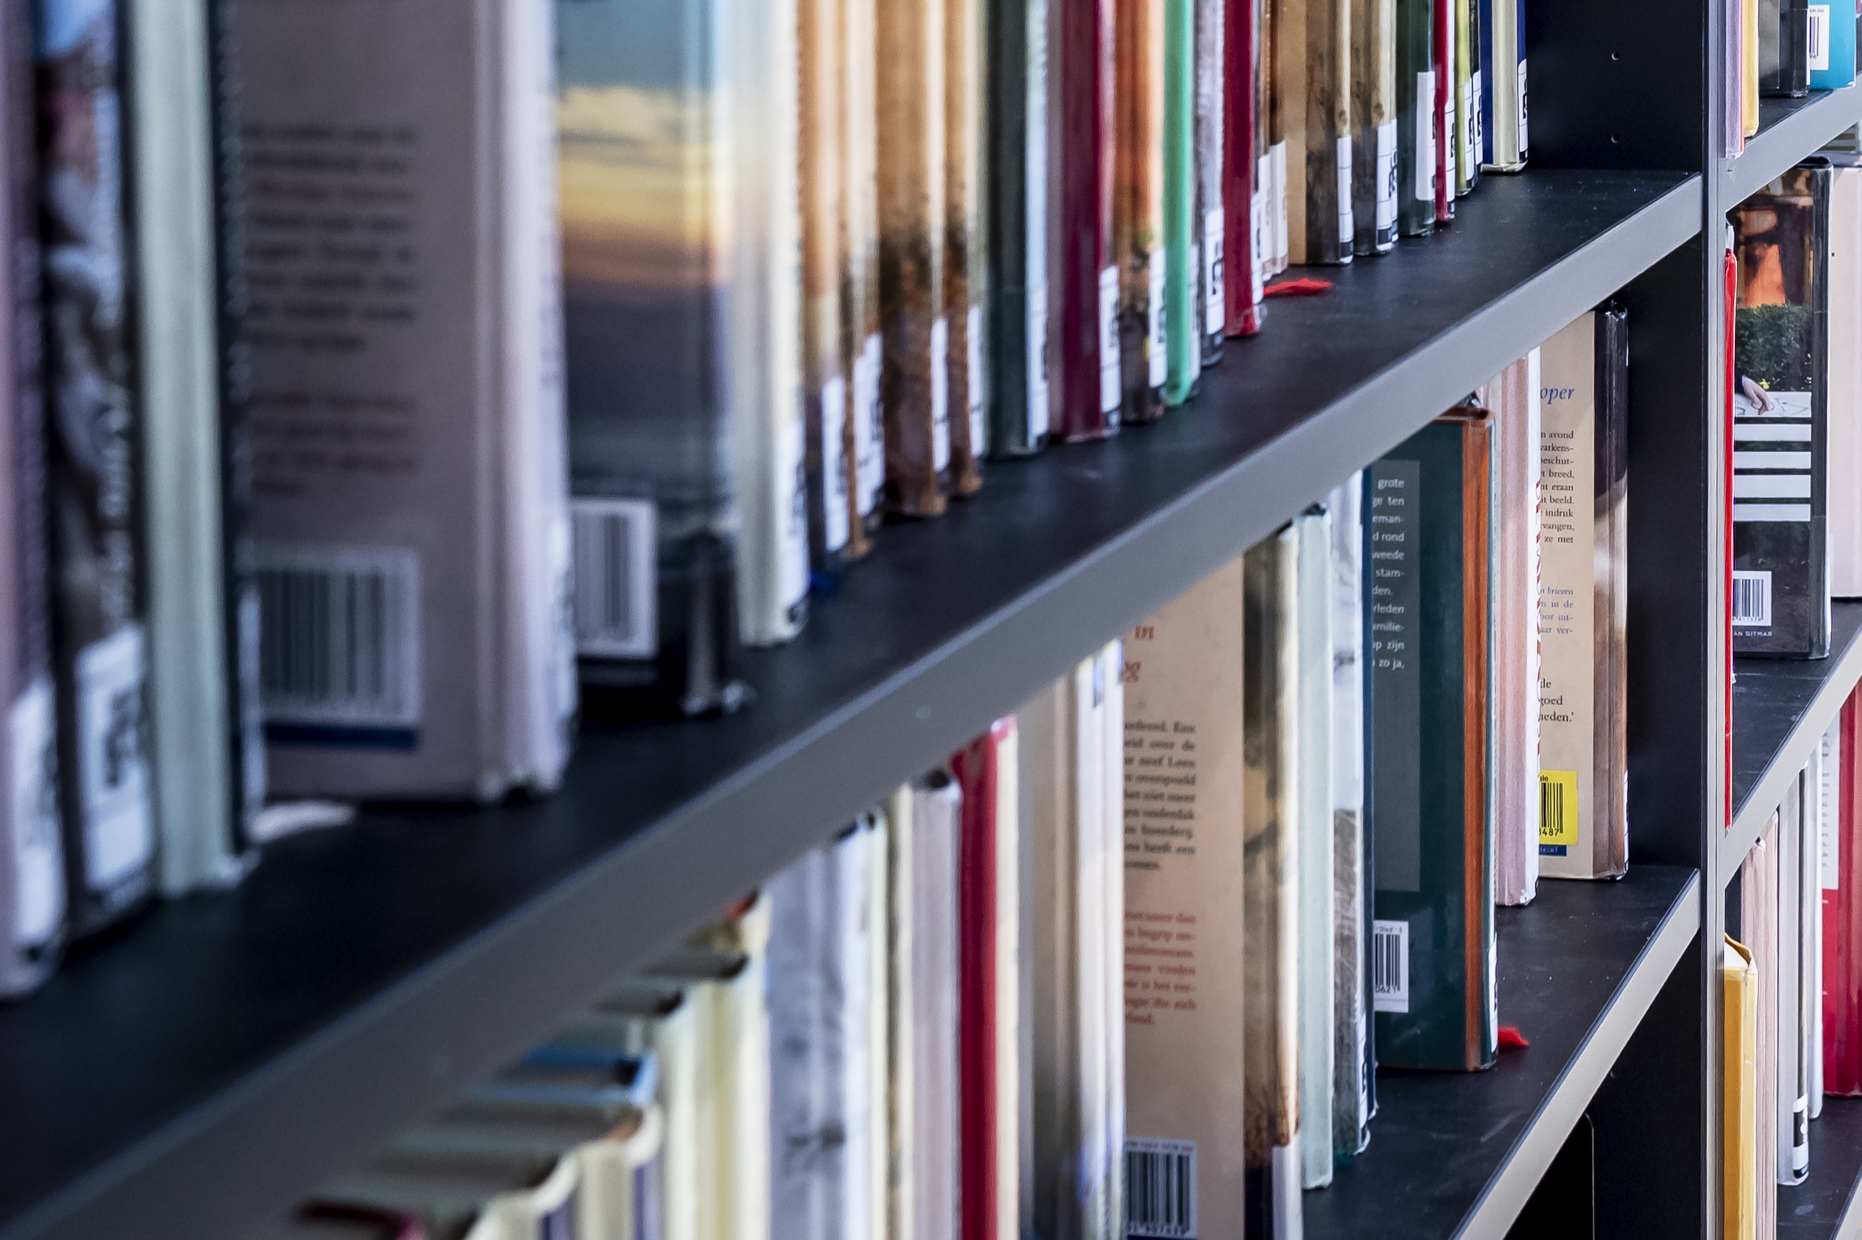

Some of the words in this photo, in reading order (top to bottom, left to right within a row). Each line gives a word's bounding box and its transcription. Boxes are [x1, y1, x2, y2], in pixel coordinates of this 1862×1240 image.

[1540, 387, 1575, 405] oper
[1548, 430, 1574, 439] avond
[1548, 469, 1575, 479] breed,
[1377, 479, 1405, 490] grote
[1387, 496, 1405, 506] ten
[1550, 495, 1575, 505] beeld.
[1545, 508, 1574, 517] indruk
[1382, 532, 1405, 542] rond
[1375, 568, 1405, 578] stam-
[1551, 599, 1559, 608] in
[1563, 599, 1574, 609] de
[1386, 640, 1405, 652] zijn
[1379, 659, 1390, 668] zo
[1392, 659, 1405, 671] ja,
